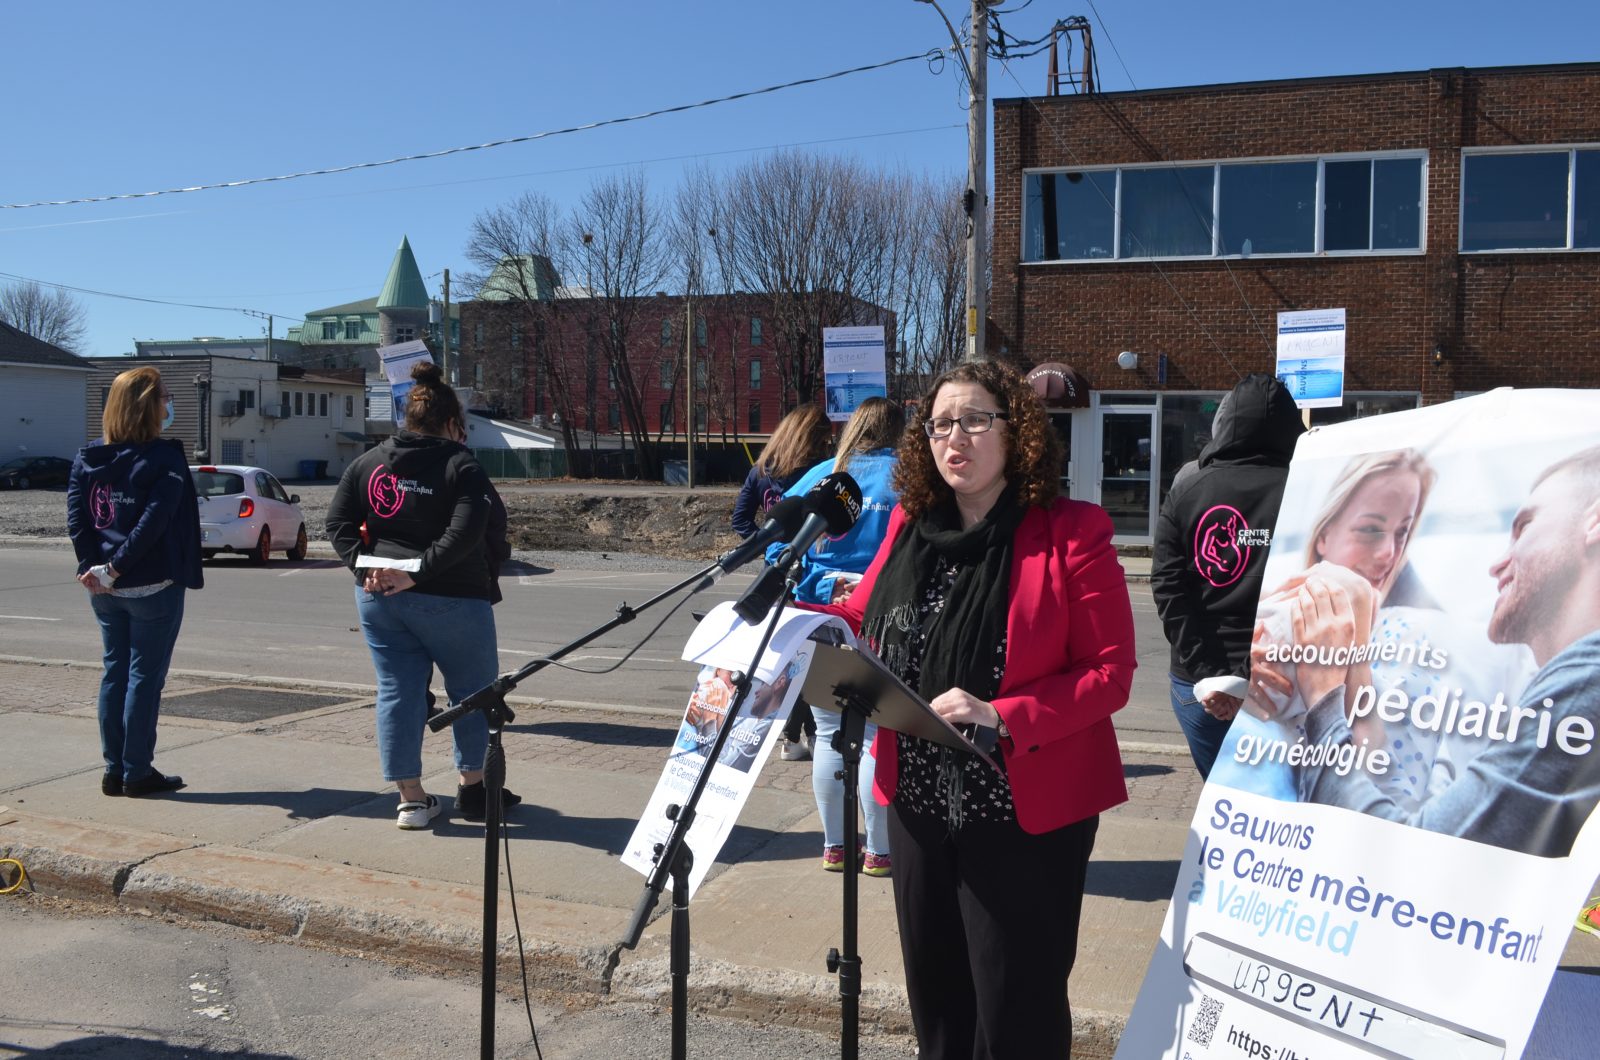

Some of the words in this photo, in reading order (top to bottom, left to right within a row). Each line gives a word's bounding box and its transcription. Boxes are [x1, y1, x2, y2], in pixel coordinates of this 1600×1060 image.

[1237, 536, 1273, 546] Mère-E
[1238, 529, 1270, 537] CENTRE
[1265, 640, 1448, 670] accouchements
[1347, 678, 1595, 755] pédiatrie
[1233, 734, 1391, 776] gynécologie
[1210, 799, 1315, 850] Sauvons
[1187, 873, 1206, 906] à
[1216, 880, 1359, 957] Valleyfield
[1198, 836, 1225, 870] le
[1233, 848, 1303, 893] Centre
[1309, 874, 1544, 964] mère-enfant
